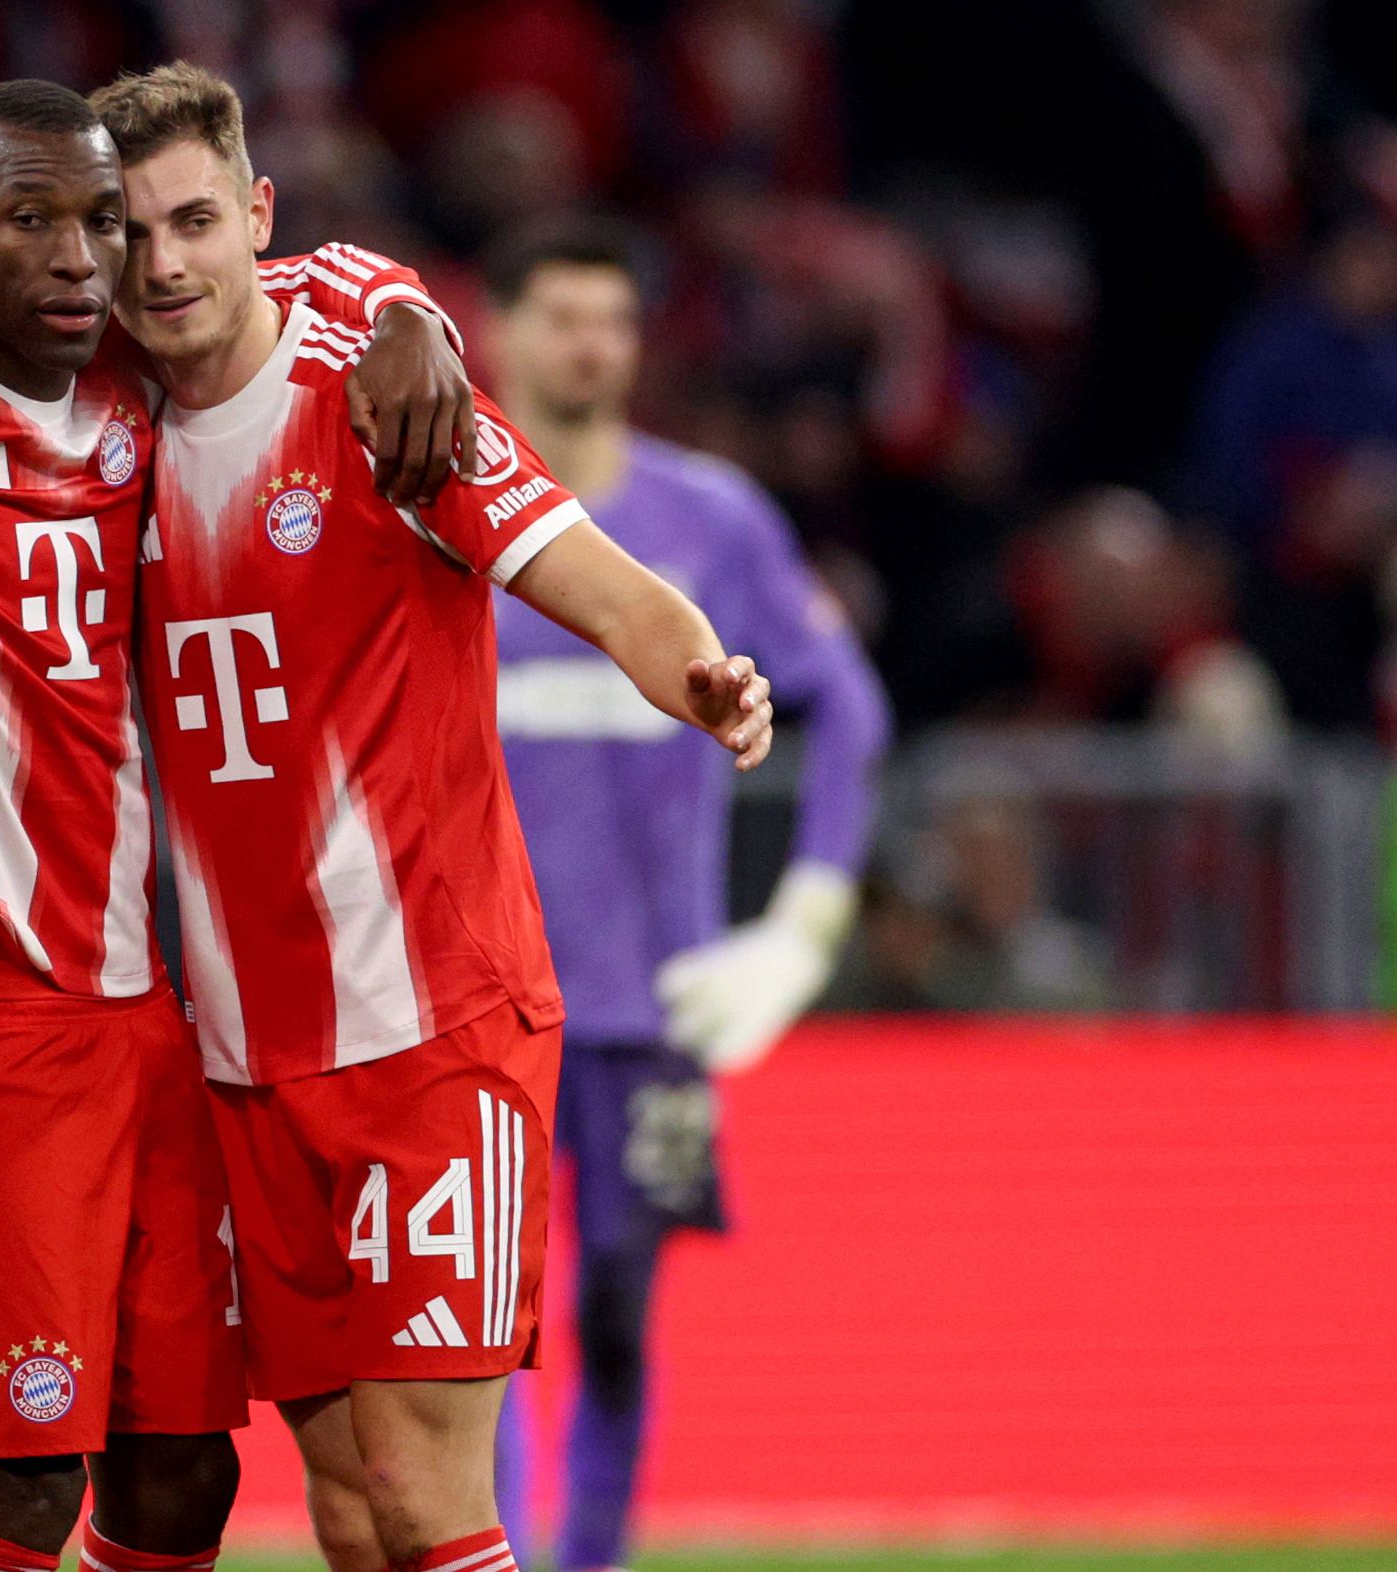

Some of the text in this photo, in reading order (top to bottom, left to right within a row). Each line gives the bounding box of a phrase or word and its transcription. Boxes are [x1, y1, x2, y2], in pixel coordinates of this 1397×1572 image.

[271, 494, 318, 519] FC BAYERN
[348, 1157, 476, 1283] 44
[14, 1362, 68, 1387] FC BAYERN
